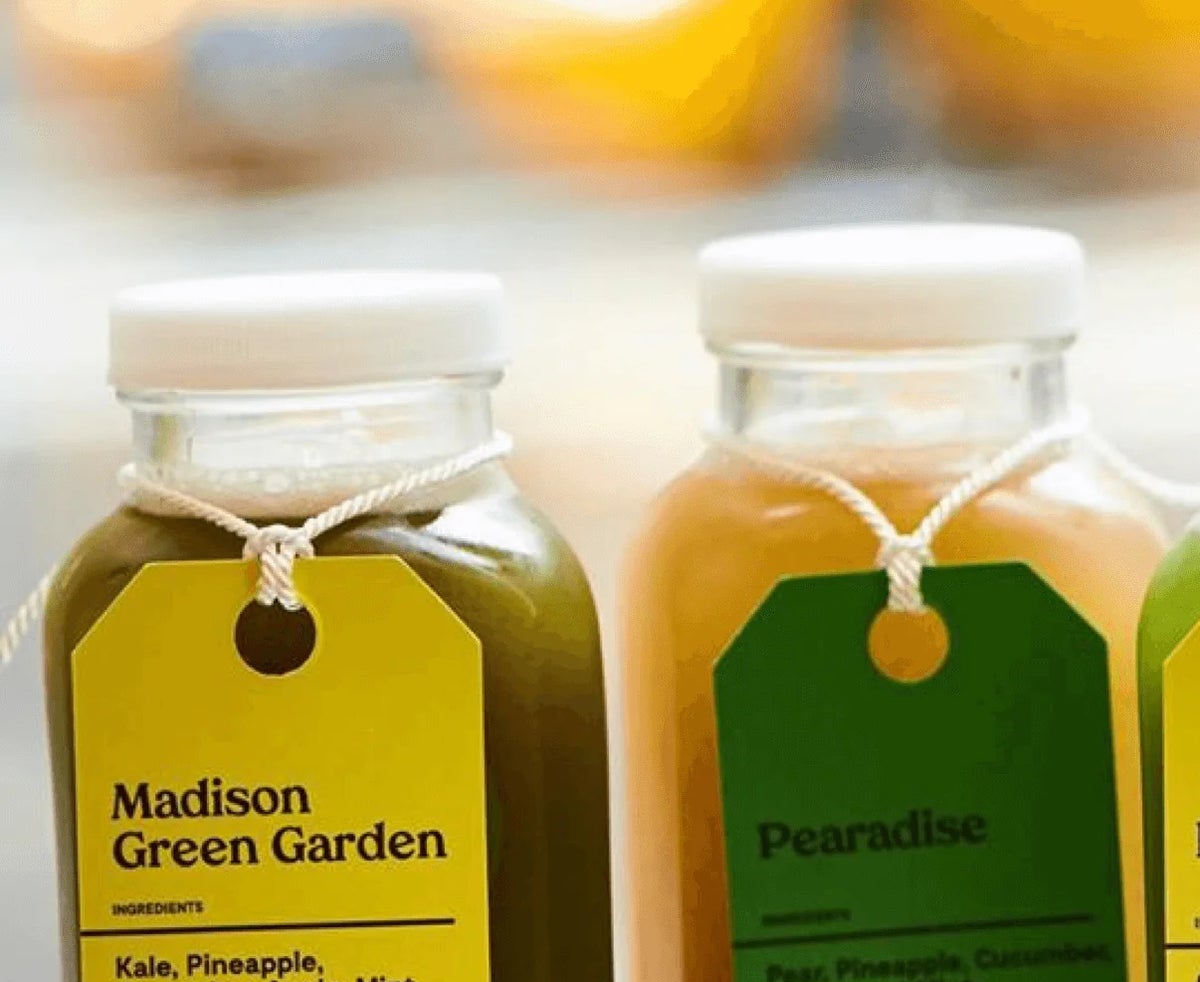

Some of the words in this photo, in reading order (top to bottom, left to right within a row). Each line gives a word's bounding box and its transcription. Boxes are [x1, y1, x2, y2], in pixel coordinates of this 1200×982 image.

[111, 778, 311, 820] Madison
[112, 830, 259, 870] Green
[271, 822, 448, 864] Garden
[757, 808, 989, 860] Pearadise
[112, 900, 204, 916] INGREDIENTS
[114, 954, 180, 981] Kale,
[185, 950, 324, 979] Pineapple,
